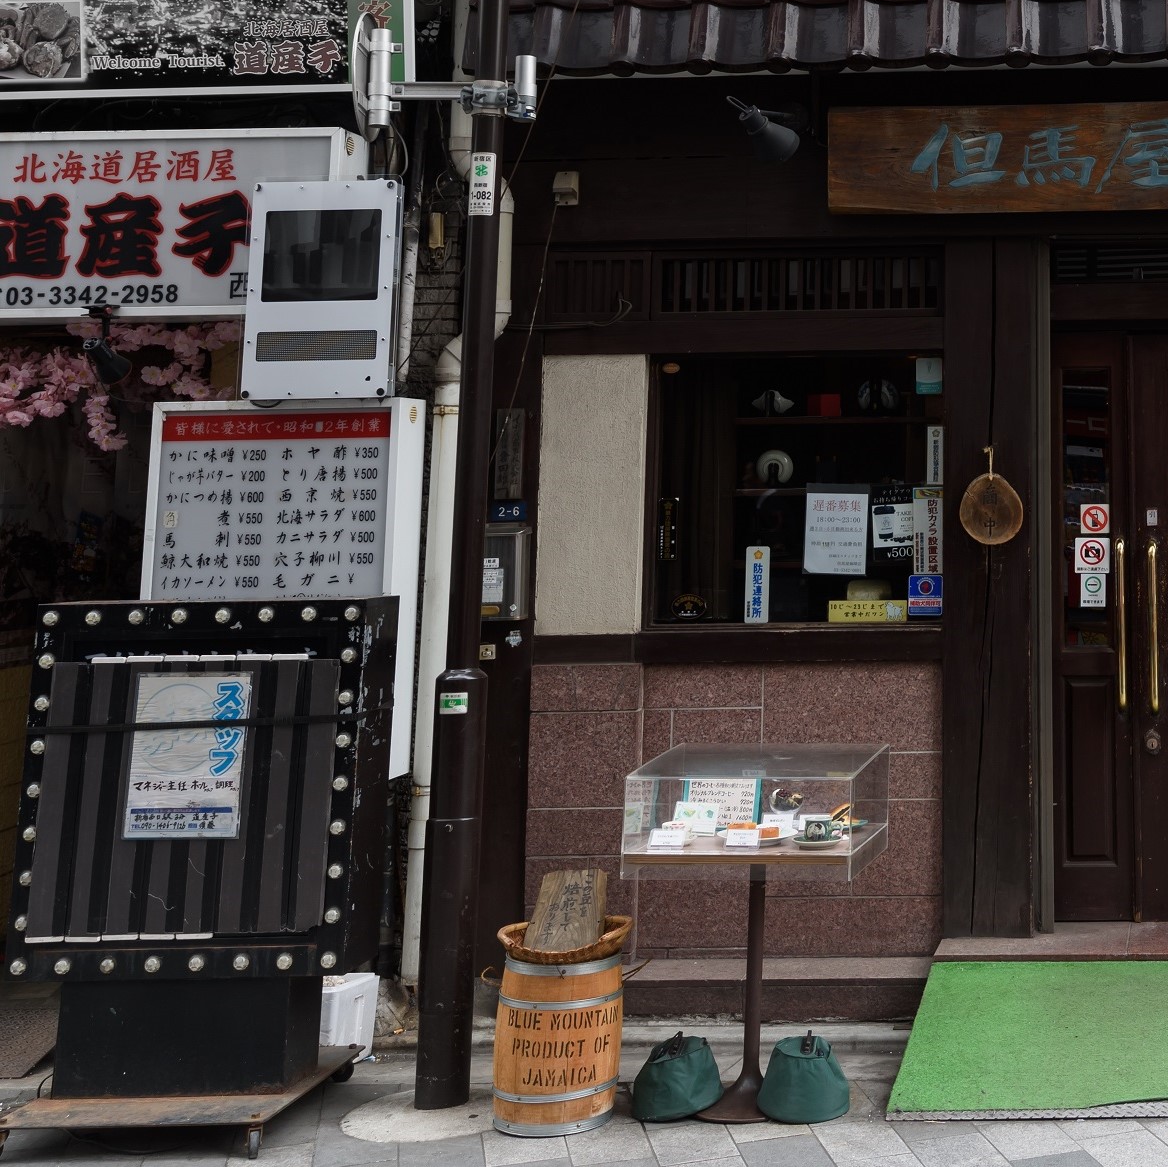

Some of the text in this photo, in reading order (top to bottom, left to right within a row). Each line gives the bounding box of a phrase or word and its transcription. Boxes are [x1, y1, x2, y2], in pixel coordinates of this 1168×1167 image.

[243, 20, 330, 38] 北海居酒屋
[93, 54, 160, 69] Welcome
[233, 39, 341, 76] 道産子
[13, 148, 238, 184] 北海道居酒屋
[470, 191, 491, 200] 1-082
[0, 190, 252, 279] 道産子
[6, 284, 179, 306] 03-3342-2958
[175, 418, 382, 436] 皆様に愛されて・昭和2年創業
[169, 448, 267, 463] かに味噌 ¥250
[282, 445, 379, 460] ホヤ酢 ¥350
[241, 470, 265, 482] ¥200
[282, 466, 378, 482] とり唐揚 ¥500
[166, 489, 264, 505] かにつめ揚 ¥600
[280, 487, 377, 503] 西京焼 ¥550
[873, 496, 913, 504] お持ち帰りコー
[498, 506, 520, 517] 2-6
[812, 500, 861, 512] 遅番募集
[239, 512, 263, 524] ¥550
[276, 507, 376, 525] 北海サラダ ¥600
[237, 534, 261, 545] ¥550
[276, 529, 375, 544] カニサラダ ¥500
[927, 499, 939, 573] 防犯カメラ設置区域
[236, 555, 260, 567] ¥550
[274, 550, 374, 567] 穴子柳川 ¥550
[887, 547, 913, 559] ¥500
[161, 575, 259, 589] イカソーメン ¥550
[751, 563, 764, 618] 防犯連絡所
[209, 681, 244, 776] スタッフ
[578, 874, 594, 917] この豆を
[560, 881, 582, 931] 焙煎して
[540, 903, 560, 945] おります
[507, 1004, 619, 1030] BLUE MOUNTAIN
[511, 1034, 611, 1058] PRODUCT OF
[521, 1063, 597, 1088] JAMAICA
